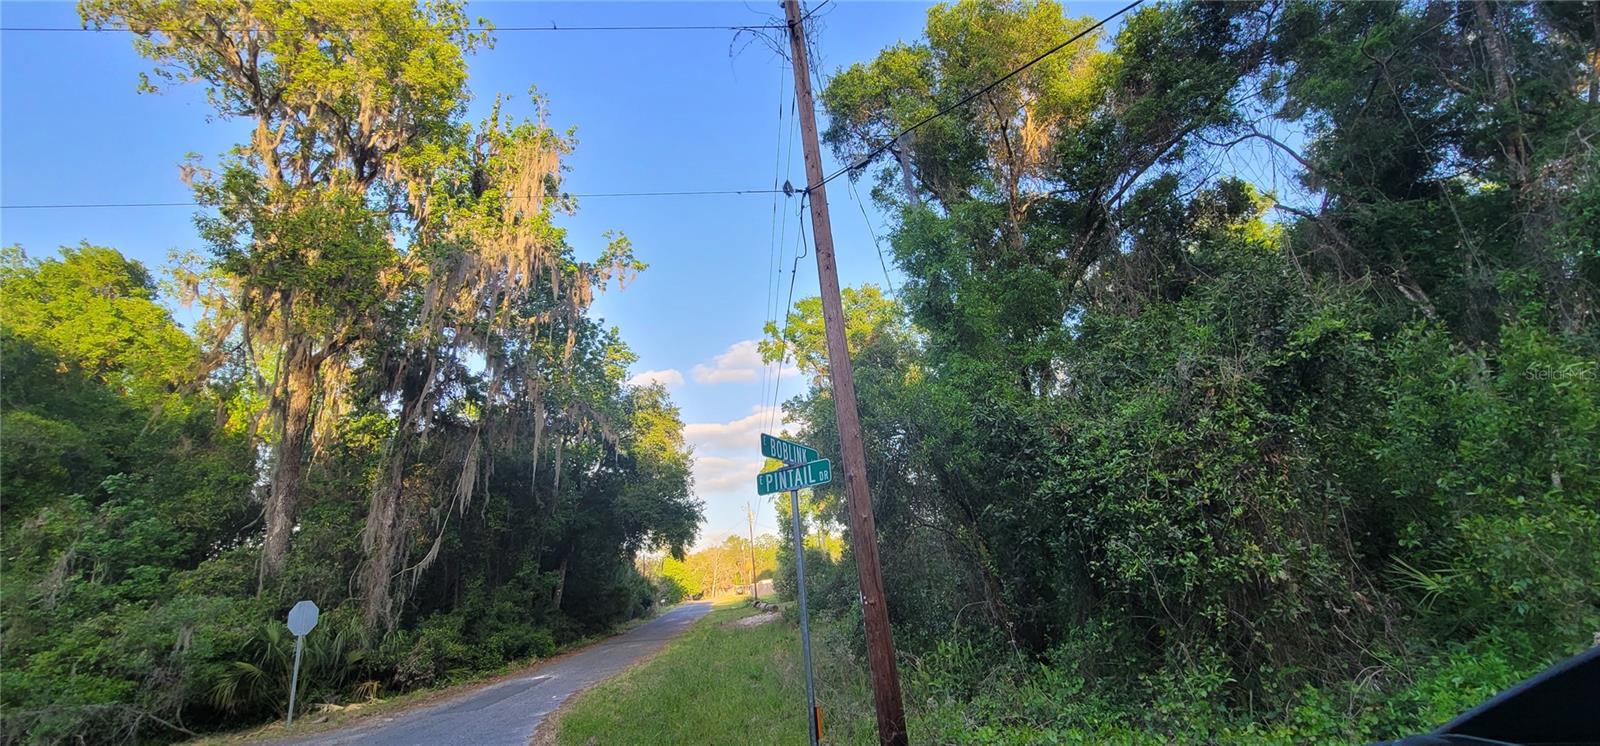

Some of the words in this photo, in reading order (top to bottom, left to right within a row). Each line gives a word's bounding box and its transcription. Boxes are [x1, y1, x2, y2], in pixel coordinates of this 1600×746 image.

[770, 438, 807, 464] BOBLINK
[766, 465, 816, 492] PINTAIL
[819, 470, 829, 481] DR
